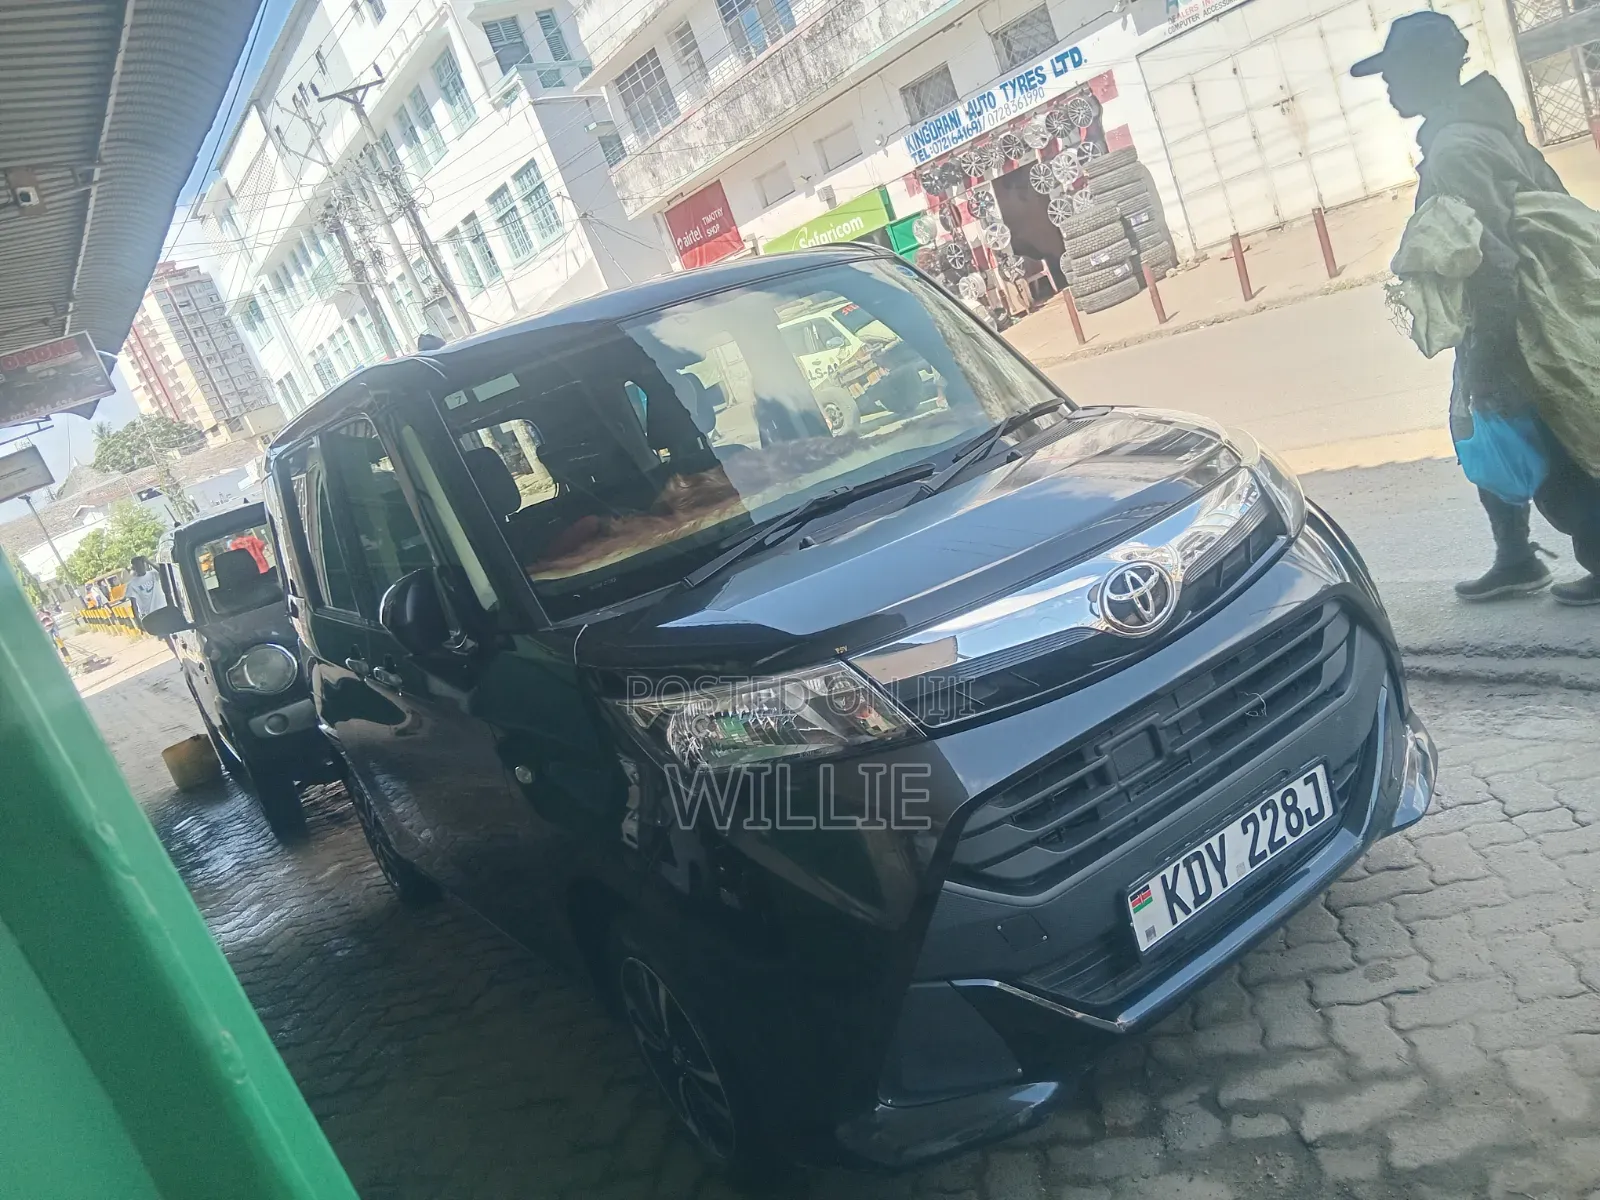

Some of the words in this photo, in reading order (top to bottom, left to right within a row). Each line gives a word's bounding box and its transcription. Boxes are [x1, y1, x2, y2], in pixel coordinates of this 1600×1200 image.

[1168, 4, 1199, 24] DEALERS
[1168, 13, 1201, 34] COMPUTER
[967, 91, 997, 121] AUTO
[999, 65, 1047, 102] TYRES
[1050, 46, 1088, 78] LTD.
[683, 226, 703, 247] airtel
[706, 223, 721, 237] SHOP
[1160, 832, 1228, 927] KDY
[1240, 771, 1326, 869] 228J
